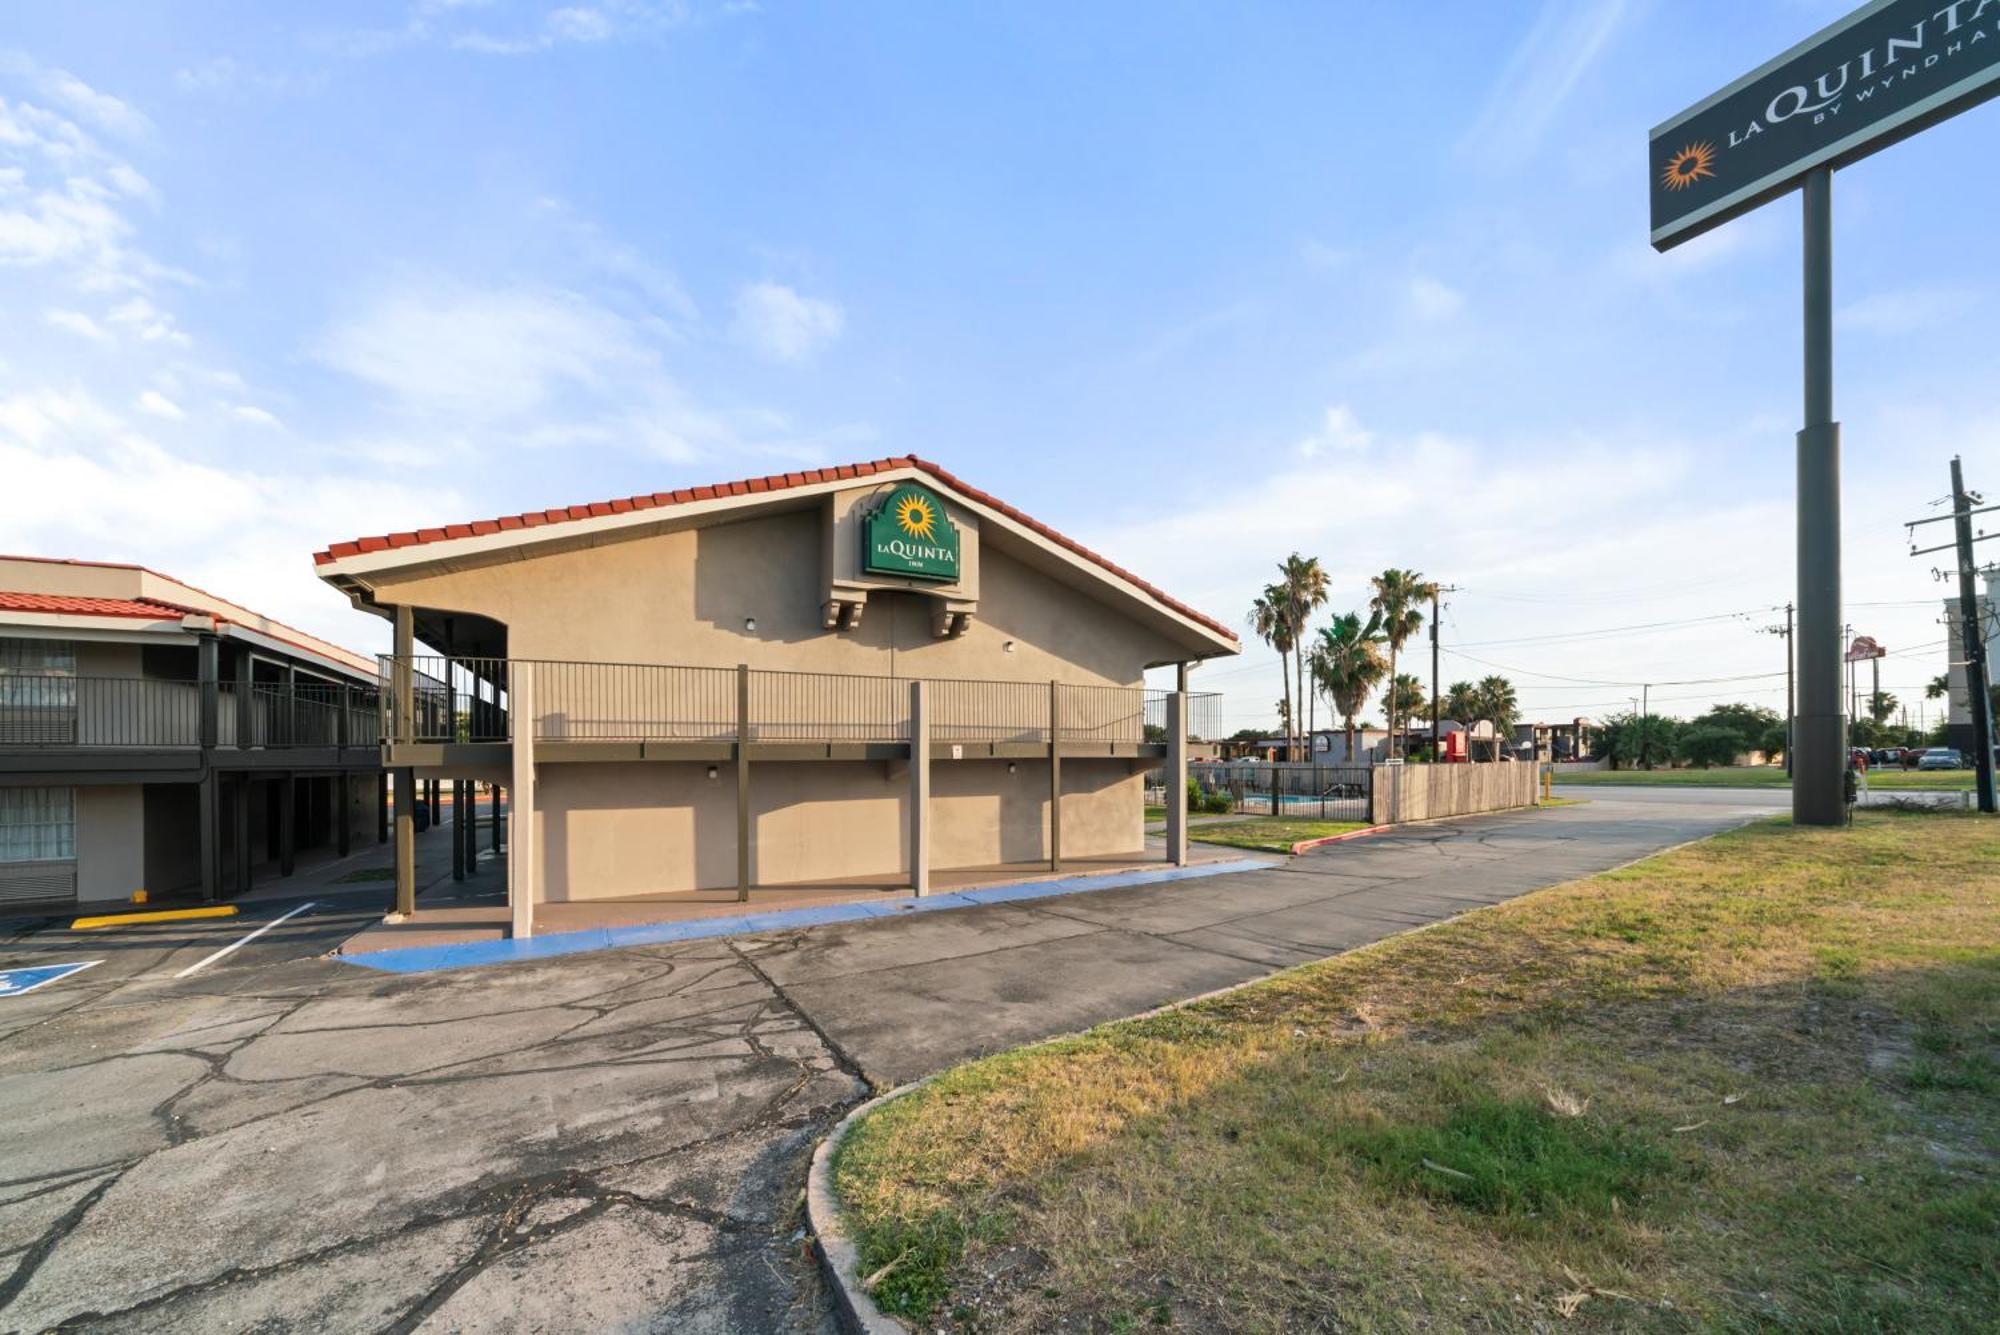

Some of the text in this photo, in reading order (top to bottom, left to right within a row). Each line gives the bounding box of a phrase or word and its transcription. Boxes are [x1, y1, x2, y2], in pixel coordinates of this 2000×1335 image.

[1814, 20, 2000, 125] BY WYNDHA
[1728, 120, 1764, 148] LA
[878, 539, 954, 562] LA QUINTA
